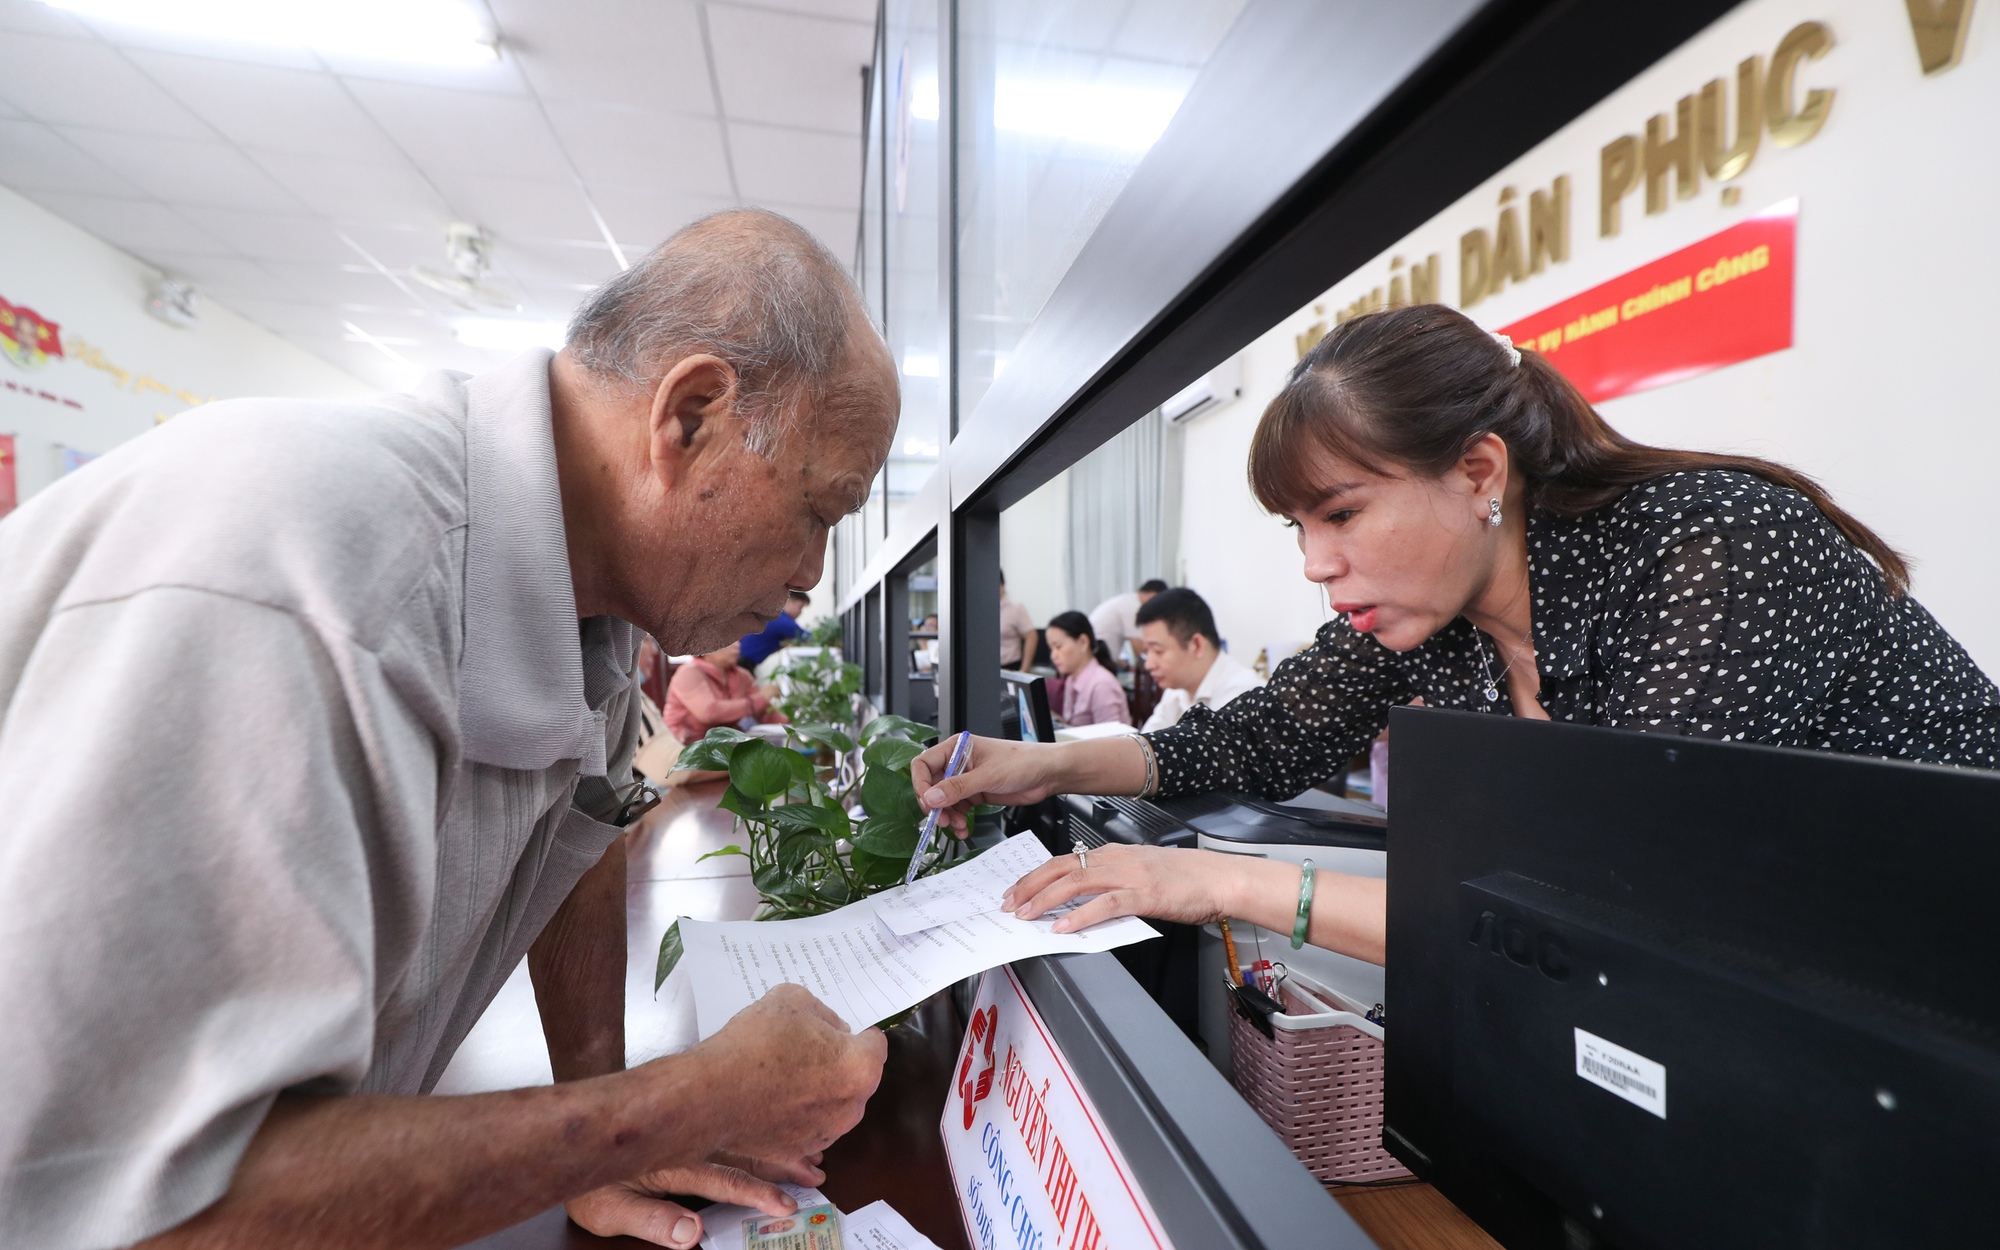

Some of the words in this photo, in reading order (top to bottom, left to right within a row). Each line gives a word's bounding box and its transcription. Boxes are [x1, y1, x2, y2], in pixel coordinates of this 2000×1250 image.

[1459, 174, 1571, 309] DÂN
[1599, 20, 1836, 239] PHỤC
[1621, 275, 1692, 321] CHÍNH
[1695, 244, 1770, 293] CÔNG
[982, 1122, 1014, 1207] CÔNG
[998, 1043, 1053, 1175] NGUYỄN
[1044, 1134, 1079, 1247] THỊ
[967, 1174, 983, 1210] SỐ
